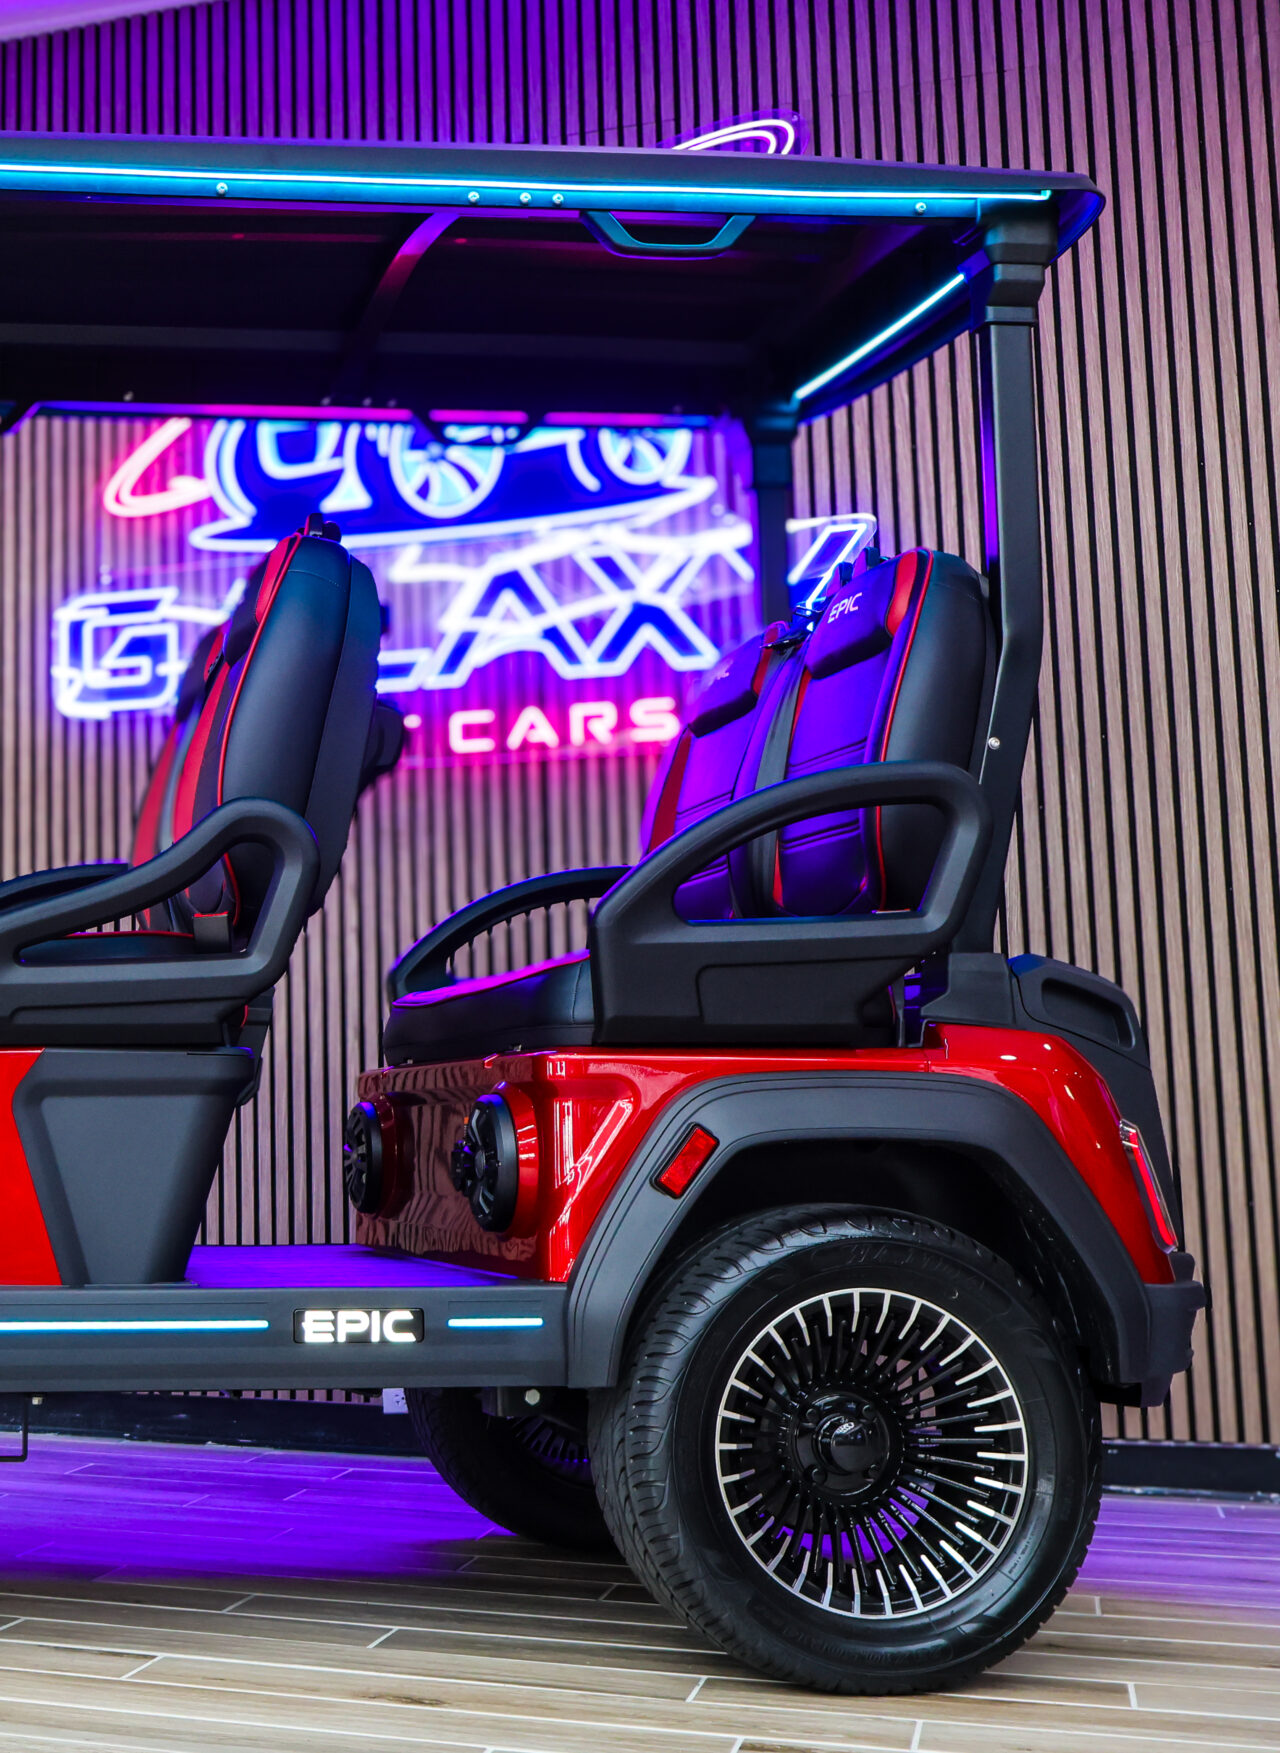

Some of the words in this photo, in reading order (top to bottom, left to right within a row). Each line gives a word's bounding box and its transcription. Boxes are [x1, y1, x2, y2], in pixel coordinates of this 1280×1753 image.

[827, 592, 863, 624] EPIC
[447, 696, 681, 754] CARS
[302, 1310, 417, 1343] EPIC
